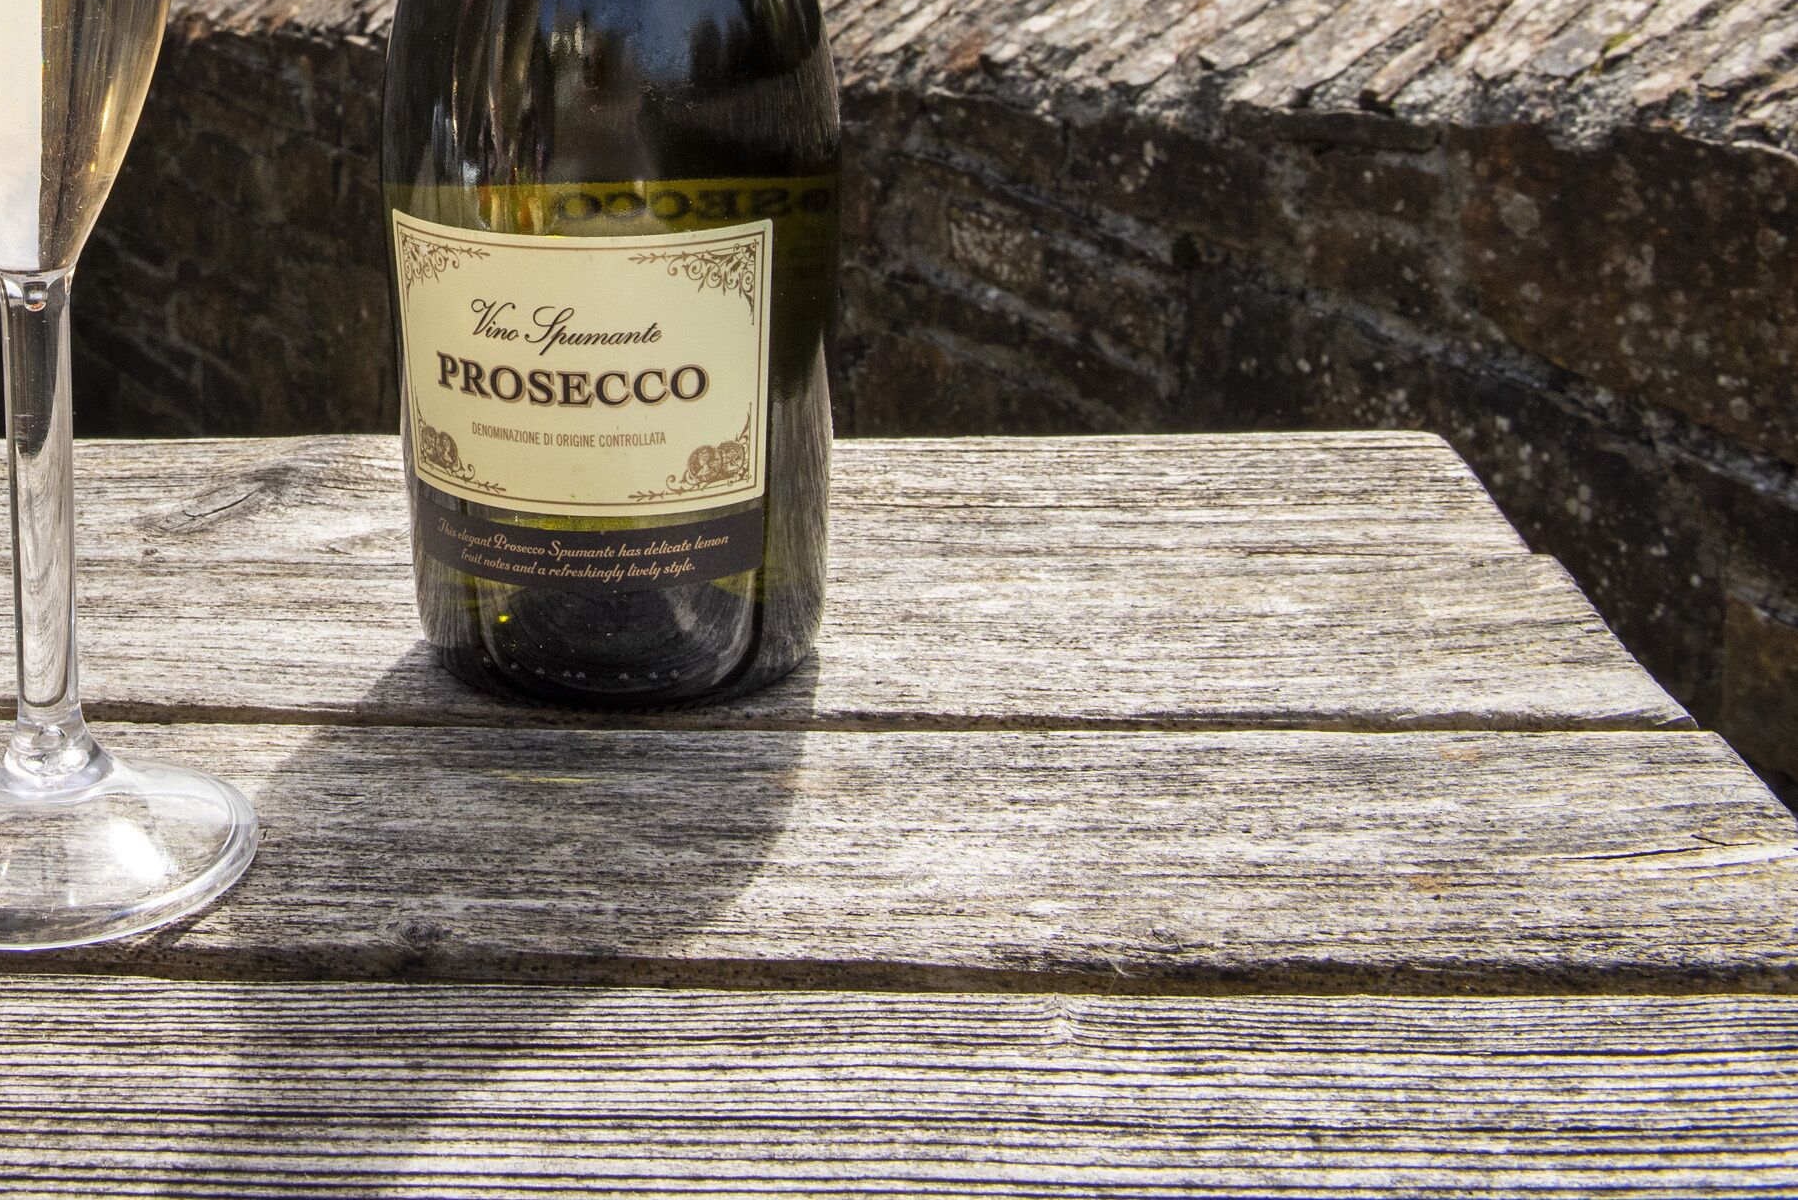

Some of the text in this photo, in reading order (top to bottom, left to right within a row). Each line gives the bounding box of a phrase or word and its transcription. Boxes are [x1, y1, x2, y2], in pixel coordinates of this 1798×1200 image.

[471, 298, 663, 356] Vino Spumante
[436, 350, 710, 409] PROSECCO
[472, 421, 666, 448] DENOMINAZIONE DI ORIGINE CONTROLLATA
[438, 517, 729, 562] This elegant Prosecco Spumante has delicate lemon
[461, 548, 695, 583] fruit notes and a refreshingly lively style.
